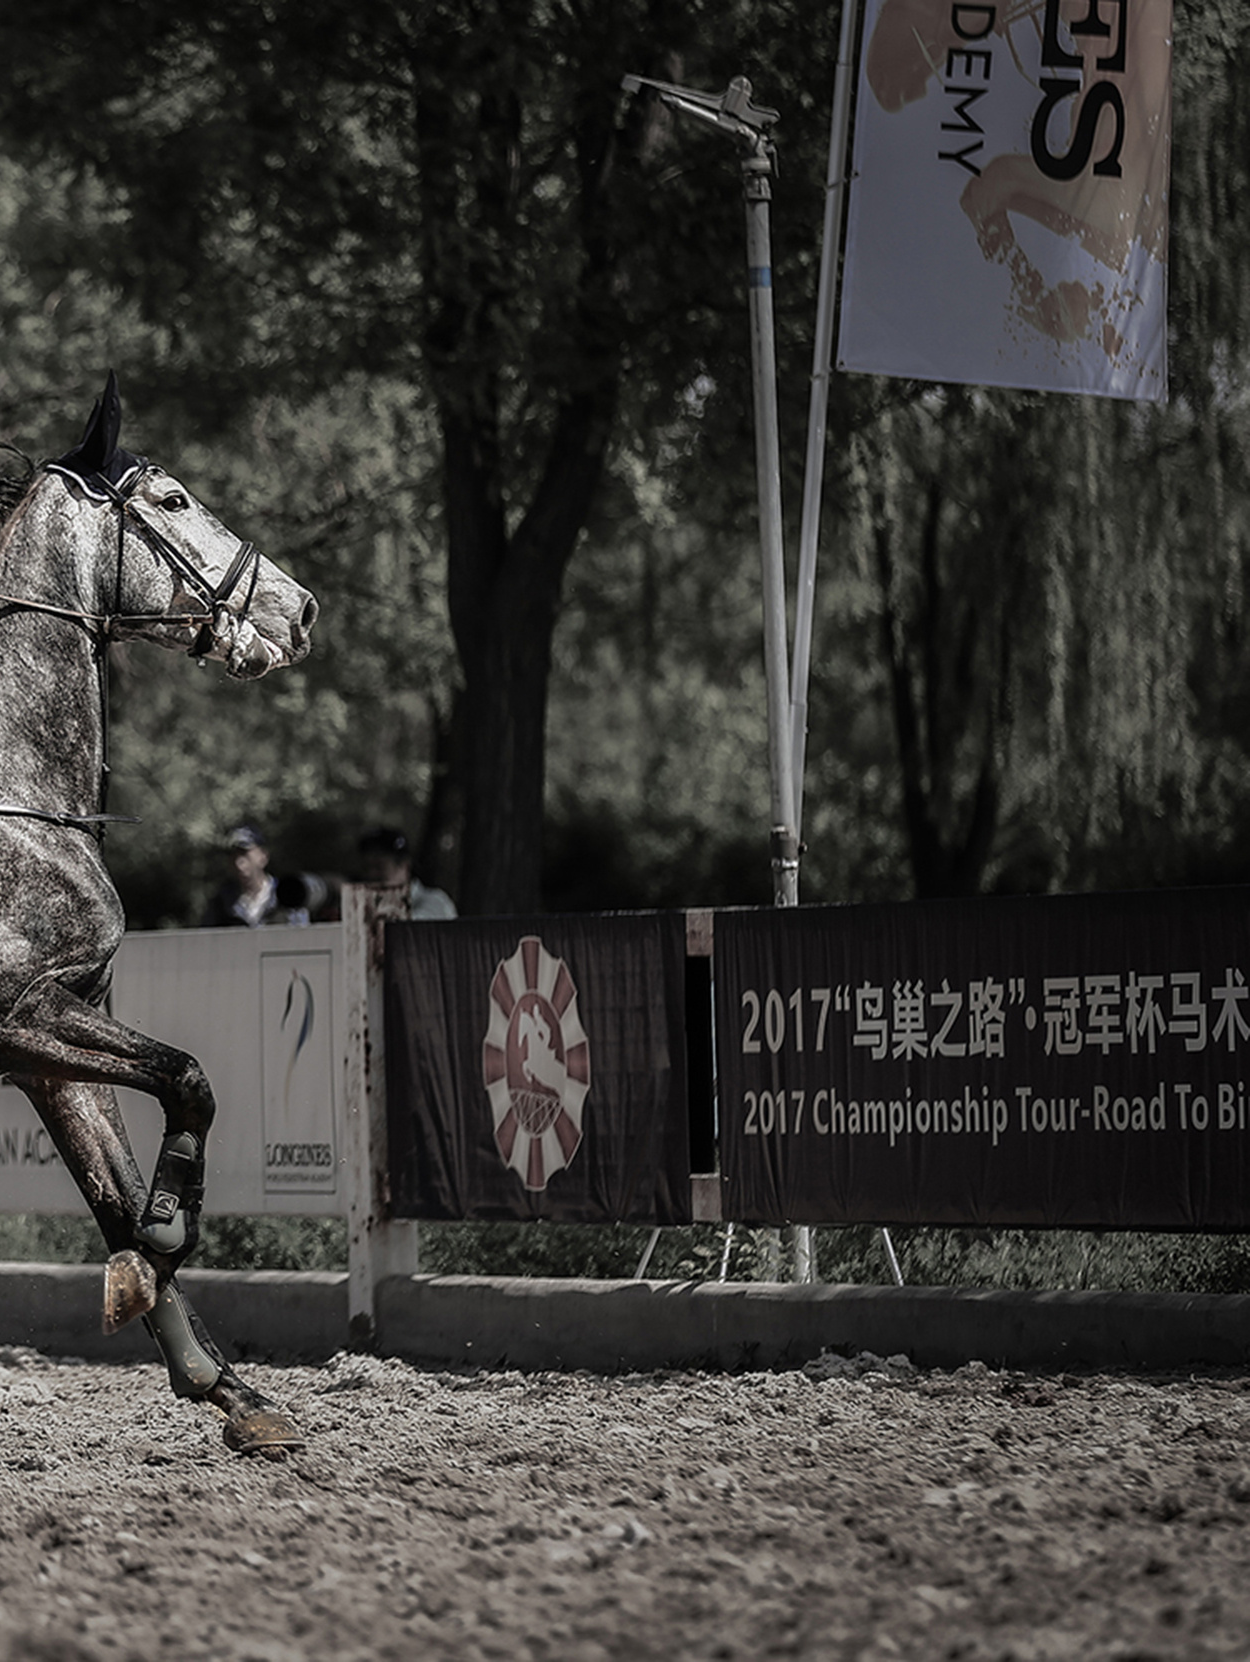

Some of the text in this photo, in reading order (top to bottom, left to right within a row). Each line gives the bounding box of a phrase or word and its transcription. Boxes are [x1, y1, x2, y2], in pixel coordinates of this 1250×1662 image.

[938, 4, 997, 178] DEMY
[744, 1081, 1250, 1146] 2017 Championship Tour-Road To Bi
[265, 1143, 333, 1167] LONGINES
